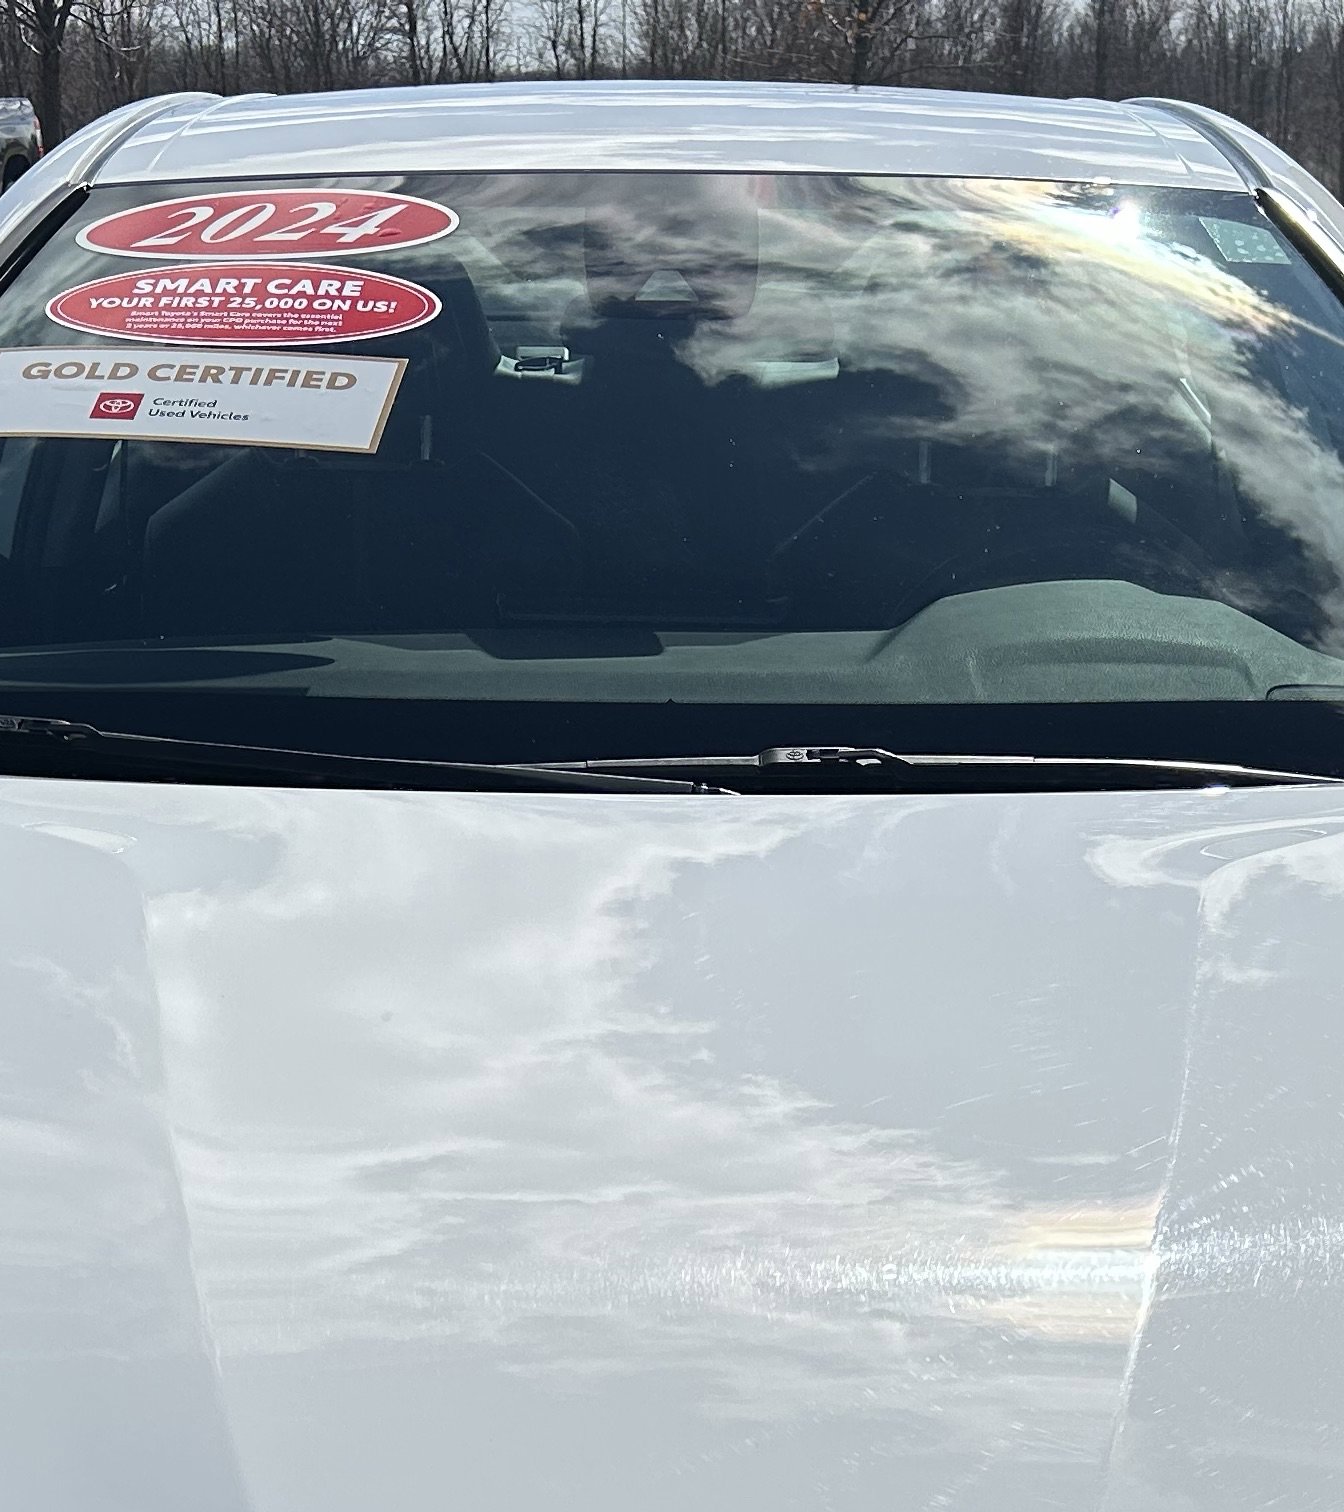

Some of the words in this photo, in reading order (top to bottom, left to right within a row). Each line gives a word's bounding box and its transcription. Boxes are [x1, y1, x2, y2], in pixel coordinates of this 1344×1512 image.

[130, 202, 409, 248] 2024
[132, 278, 262, 294] SMART
[266, 278, 364, 297] CARE
[89, 297, 154, 308] YOUR
[158, 297, 225, 308] FIRST
[227, 297, 308, 310] 25,000
[312, 298, 352, 311] ON
[356, 299, 397, 314] US!
[22, 361, 139, 380] GOLD
[146, 362, 358, 390] CERTIFIED
[153, 398, 217, 408] Certified
[148, 409, 186, 418] Used
[190, 410, 249, 421] Vehicles
